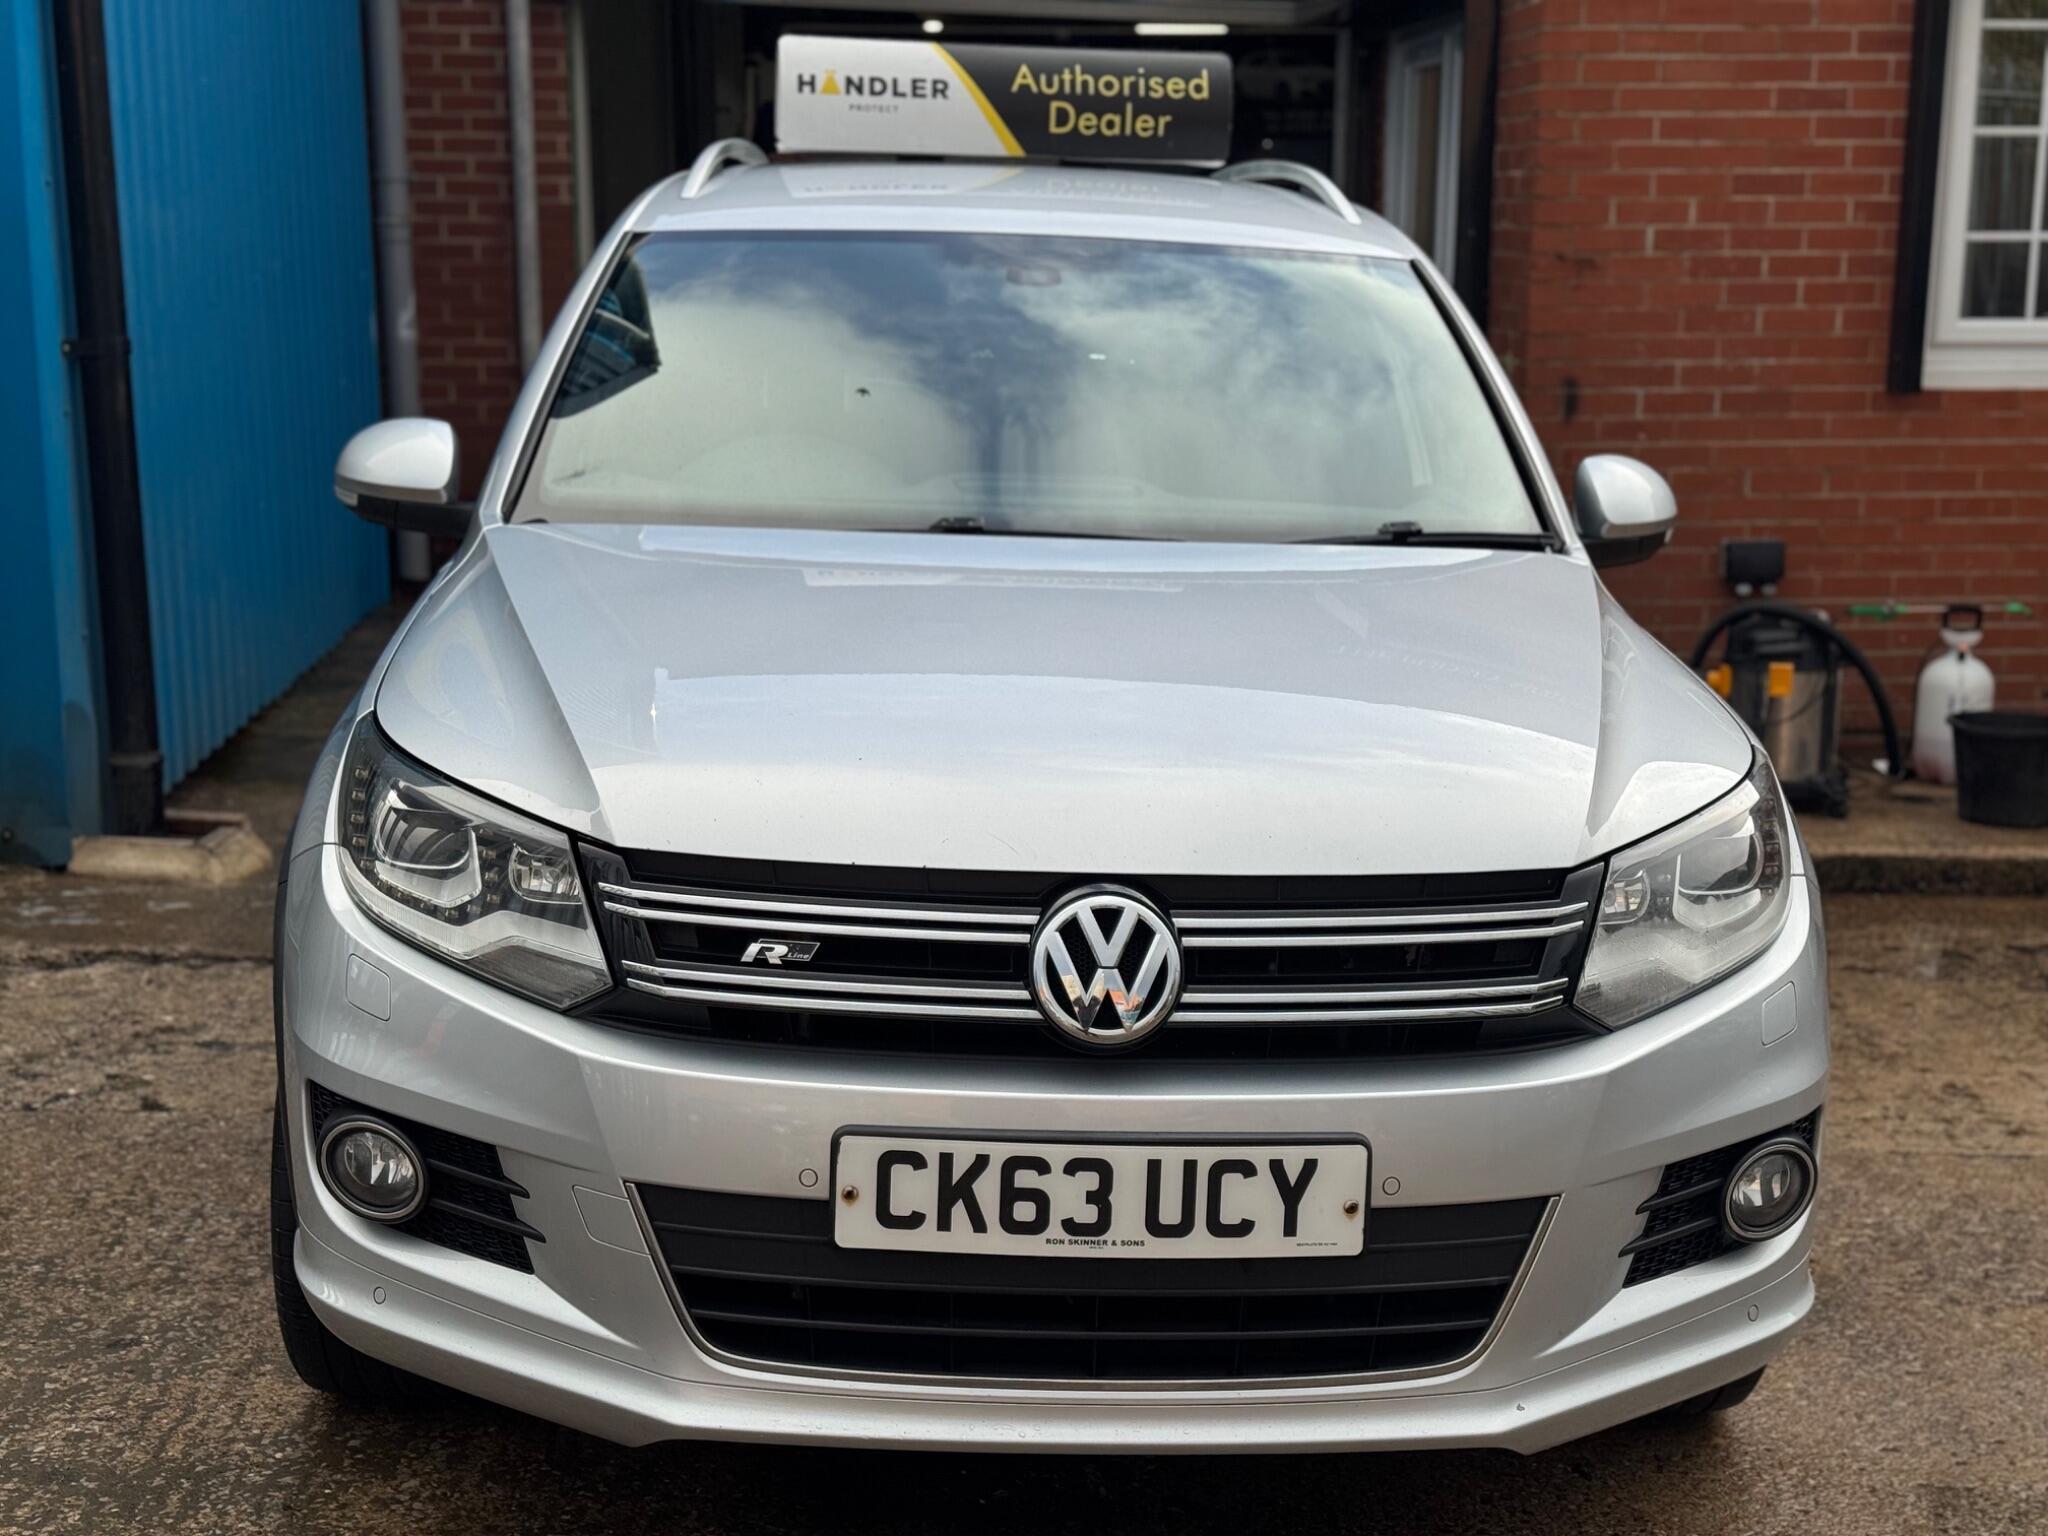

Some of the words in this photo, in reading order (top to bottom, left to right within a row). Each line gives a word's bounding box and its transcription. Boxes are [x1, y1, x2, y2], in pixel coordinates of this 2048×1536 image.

[1010, 63, 1210, 100] Authorised
[848, 104, 900, 114] PROTECT
[1048, 100, 1173, 138] Dealer
[874, 1148, 1114, 1238] CK63
[1144, 1157, 1319, 1240] UCY
[1068, 1238, 1108, 1246] SKINNER
[1120, 1239, 1145, 1247] SONS
